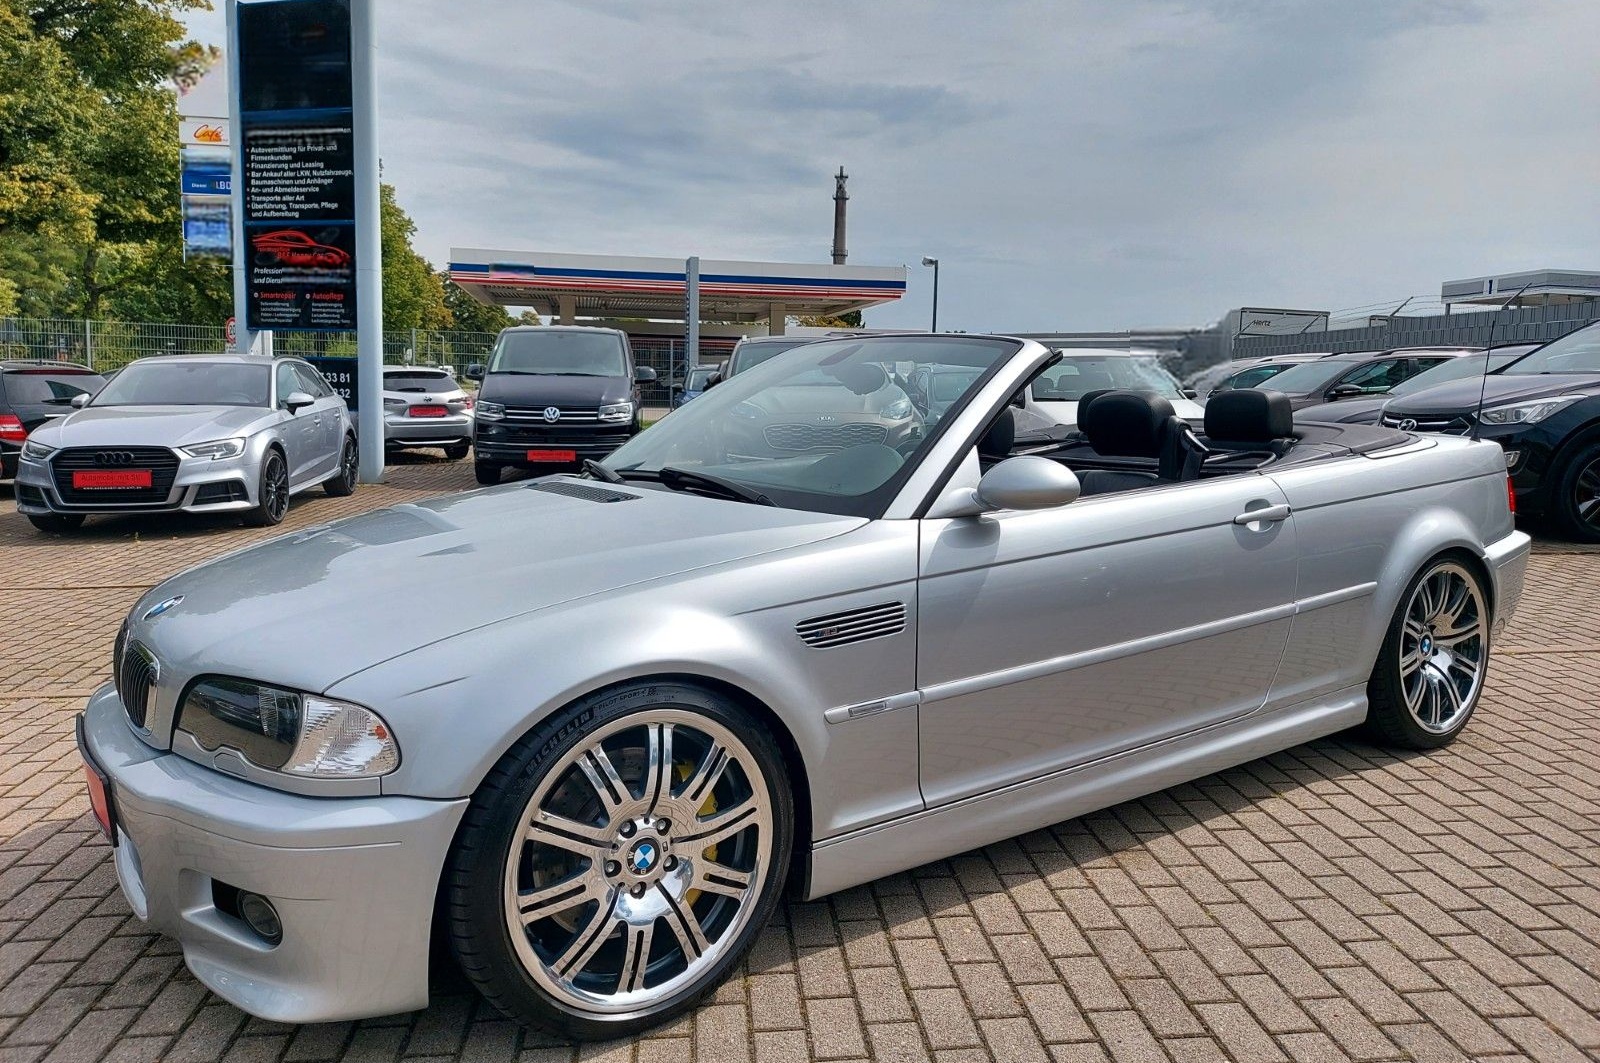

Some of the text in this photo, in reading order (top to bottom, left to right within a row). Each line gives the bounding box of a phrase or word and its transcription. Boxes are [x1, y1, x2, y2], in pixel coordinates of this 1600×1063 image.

[250, 146, 297, 154] Autovermittlung
[306, 178, 333, 186] Anhänger
[260, 292, 297, 300] Smartrepair
[312, 292, 344, 300] Autopflege
[339, 372, 351, 383] 81
[339, 388, 351, 399] 32
[598, 698, 618, 710] PILOT
[620, 691, 641, 701] SPORT
[525, 711, 590, 775] MICHELIN
